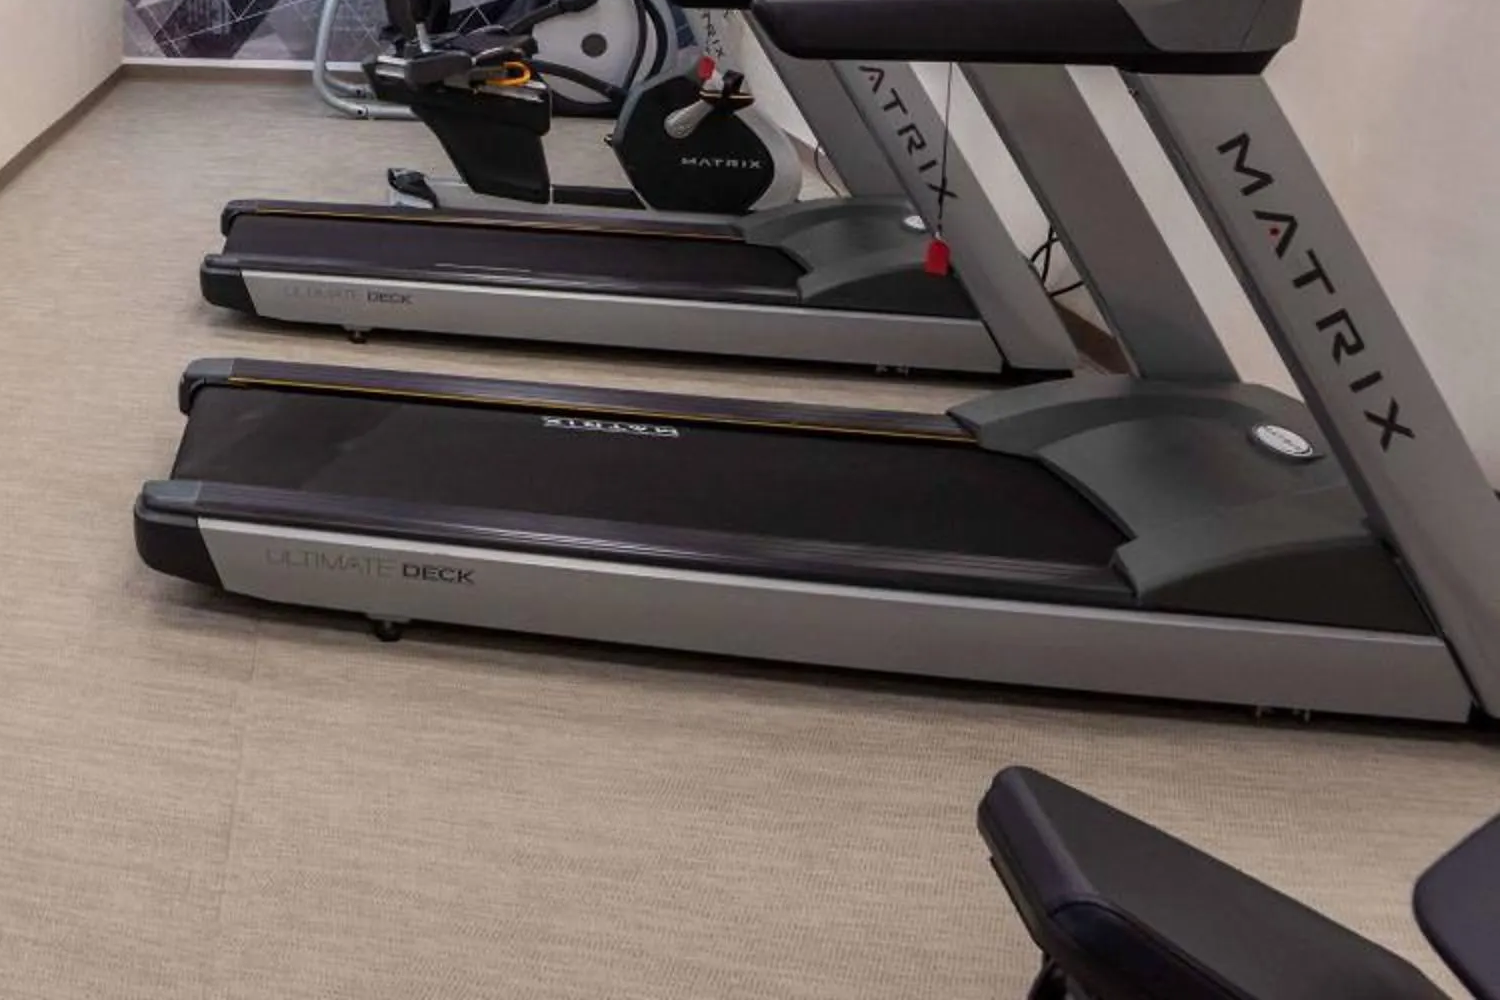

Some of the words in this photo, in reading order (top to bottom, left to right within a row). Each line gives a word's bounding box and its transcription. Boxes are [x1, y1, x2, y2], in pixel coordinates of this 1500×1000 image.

[681, 157, 761, 169] MATRIX
[858, 64, 958, 205] ATRIX
[1217, 132, 1415, 452] MATRIX
[265, 548, 396, 577] ULTIMATE
[402, 563, 476, 584] DECK
